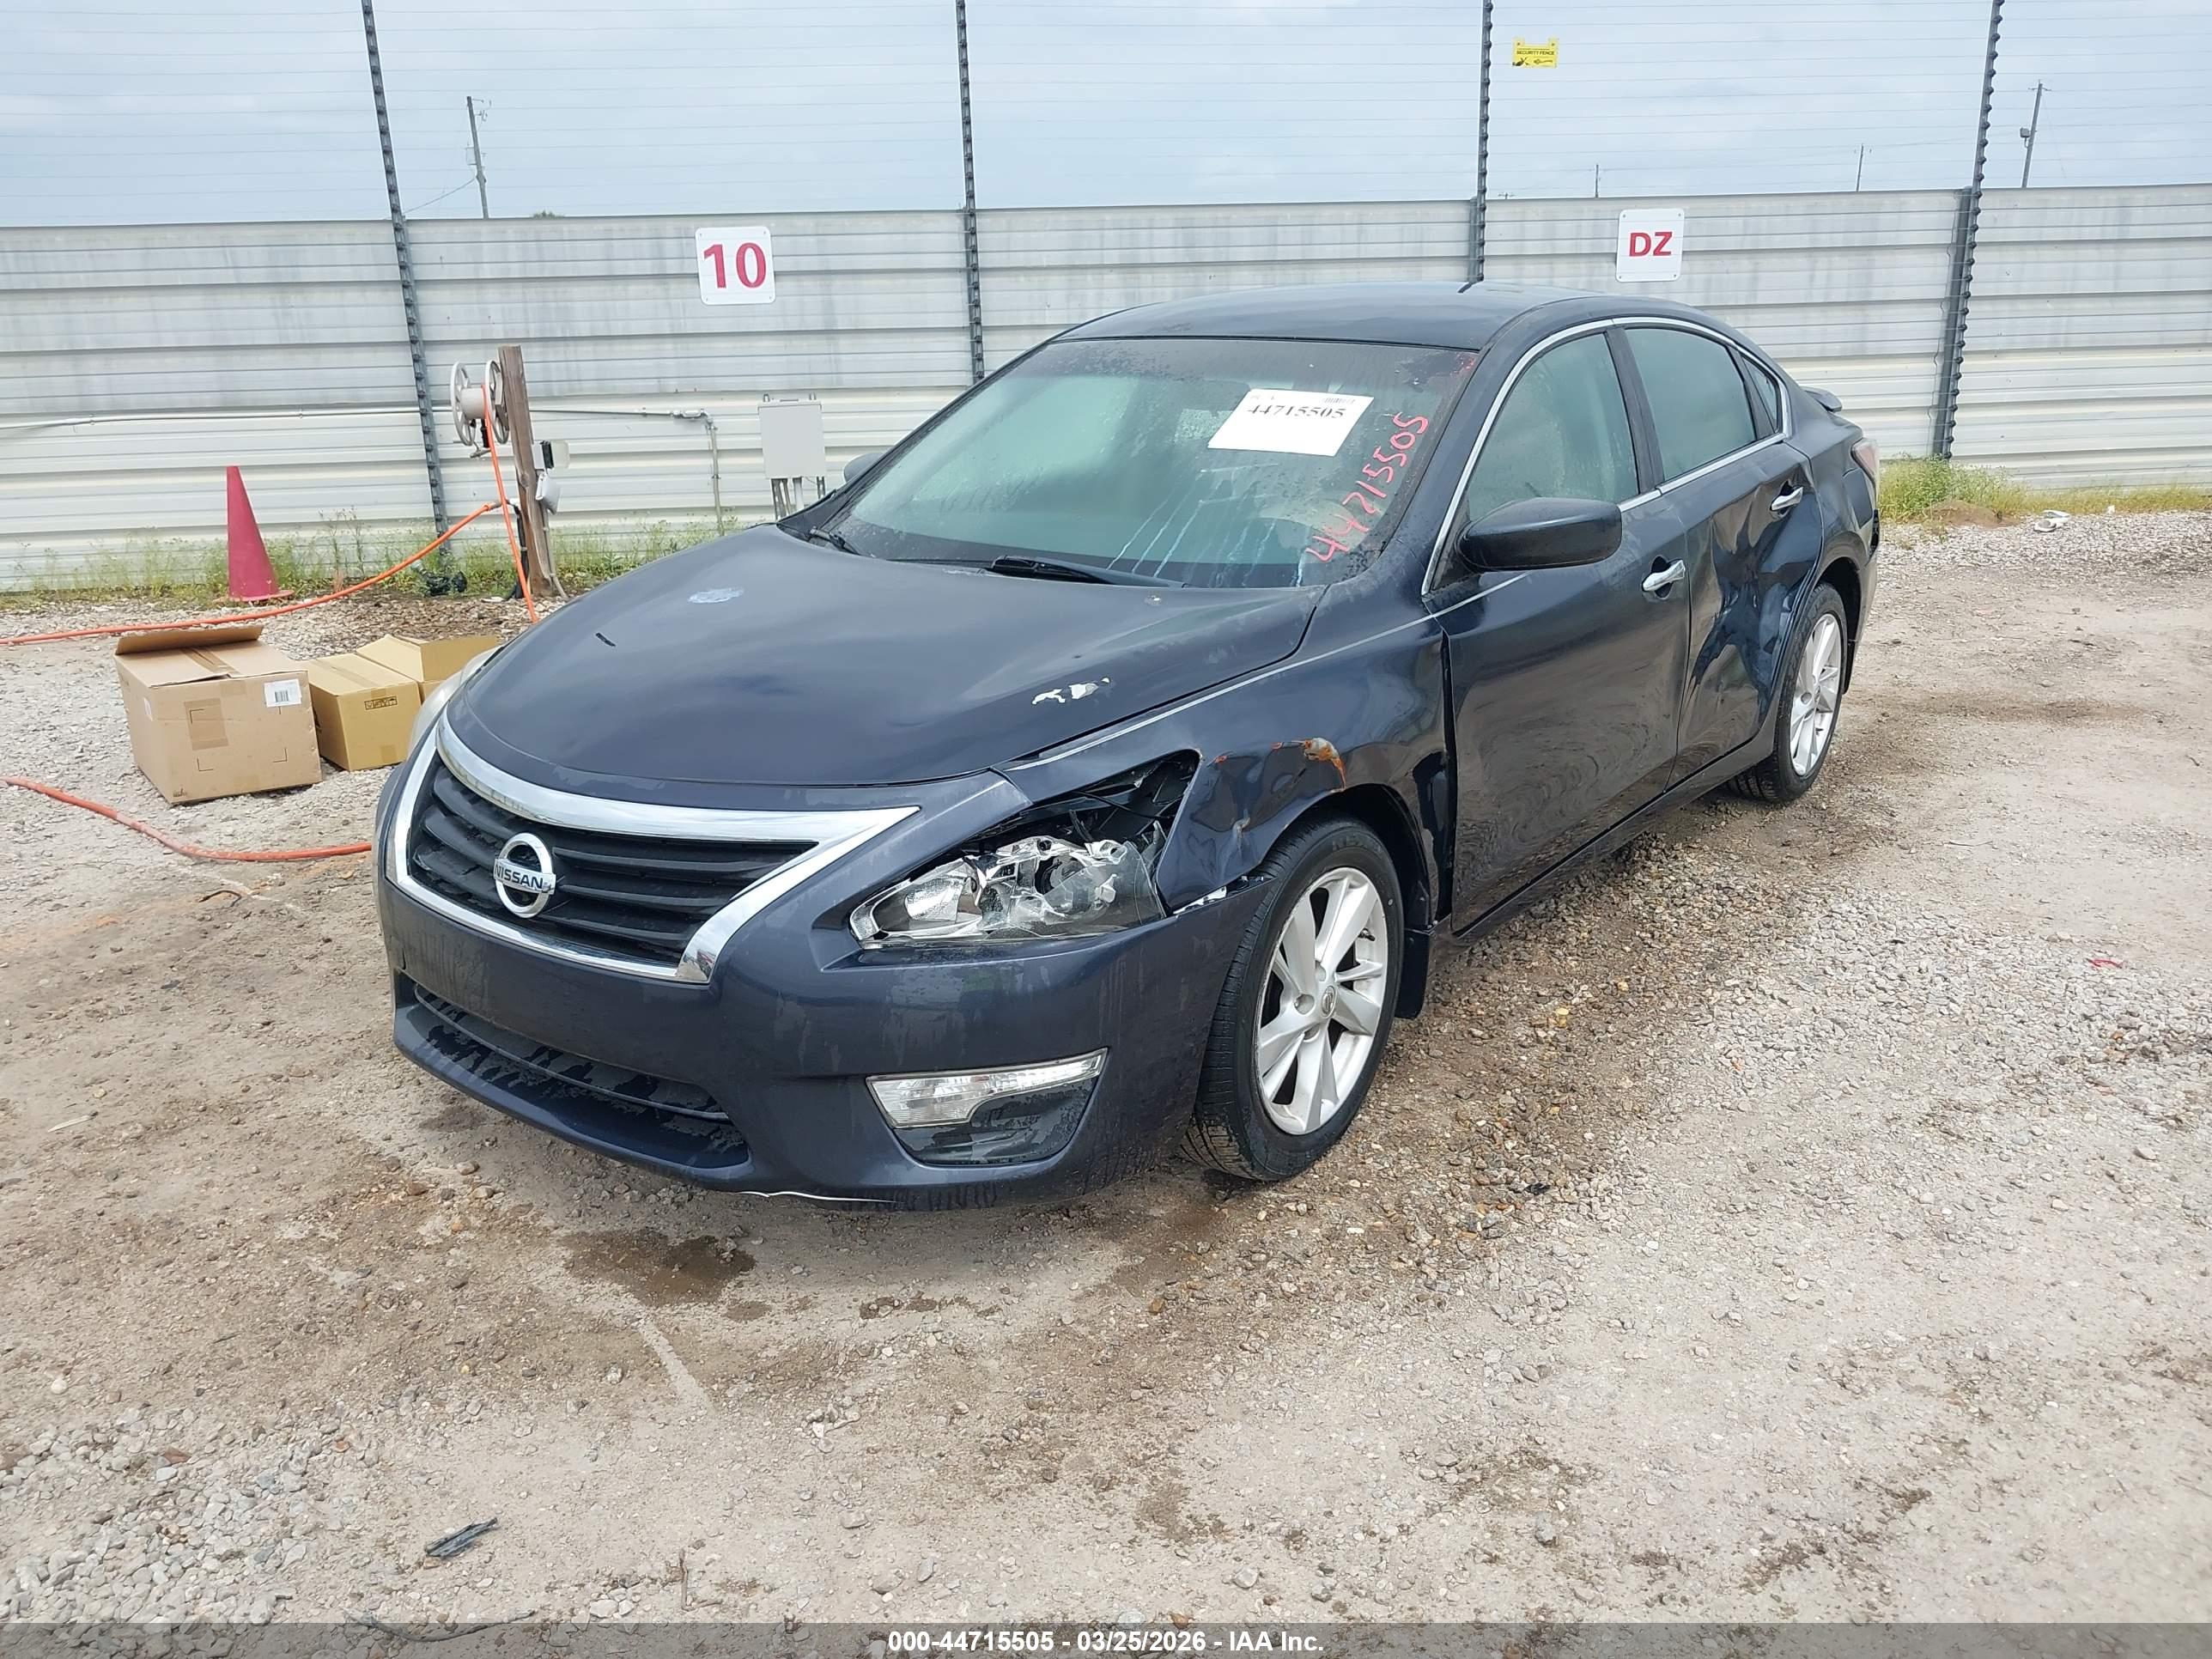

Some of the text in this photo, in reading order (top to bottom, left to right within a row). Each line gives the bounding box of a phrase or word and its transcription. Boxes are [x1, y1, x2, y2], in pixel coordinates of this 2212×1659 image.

[1629, 232, 1673, 257] DZ
[703, 242, 767, 289] 10
[1247, 404, 1346, 419] 44715505
[1305, 411, 1429, 563] 44715505
[494, 864, 544, 890] NISSAN
